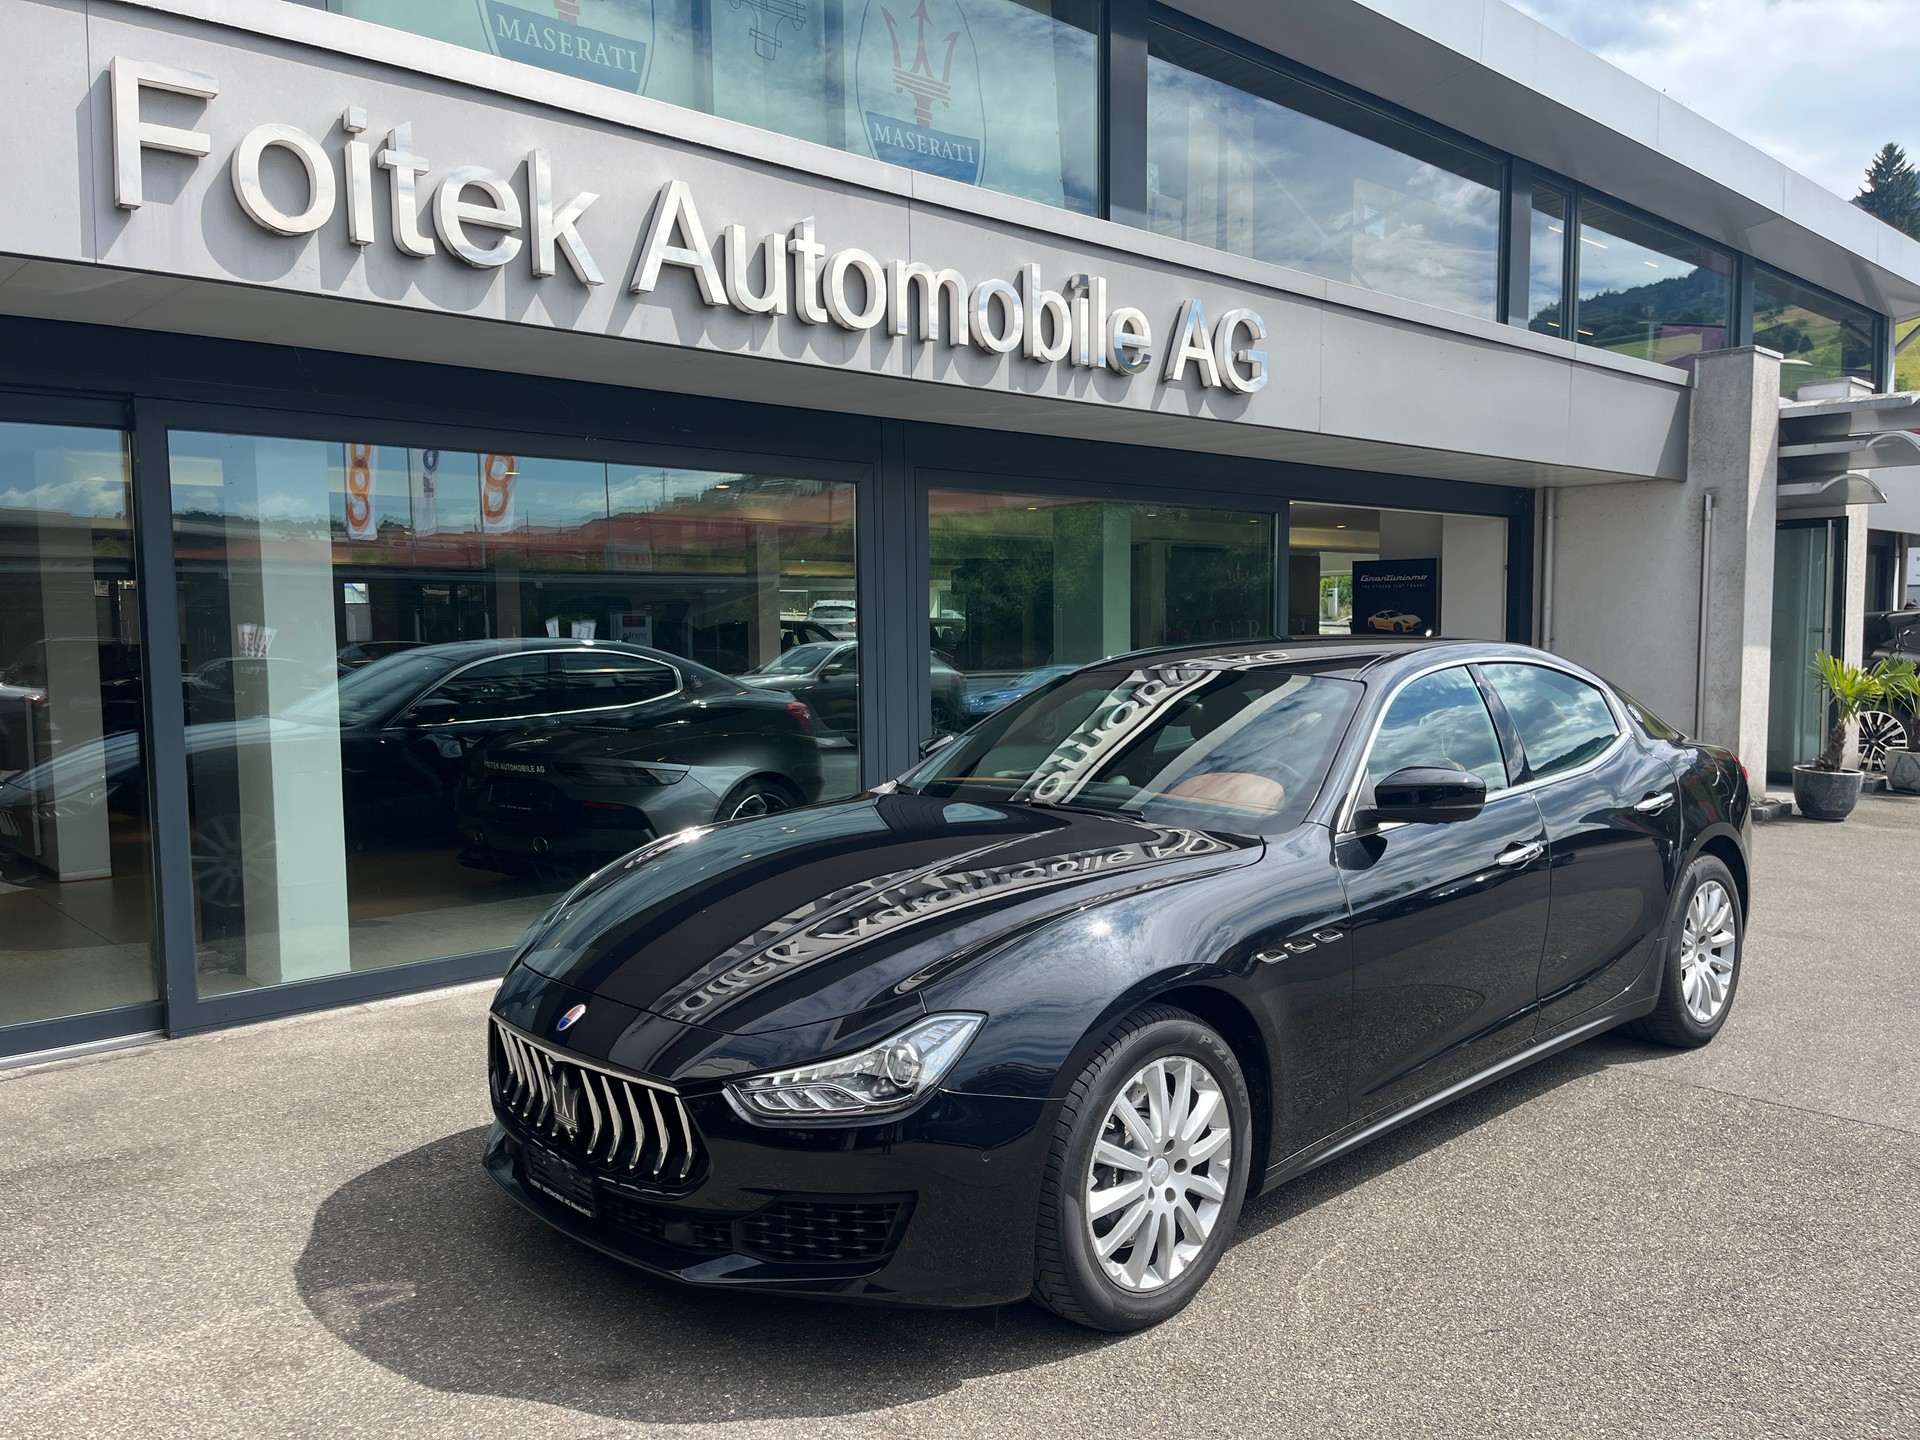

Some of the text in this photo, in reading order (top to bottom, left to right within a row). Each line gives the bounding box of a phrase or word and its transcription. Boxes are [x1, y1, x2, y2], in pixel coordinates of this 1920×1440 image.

[496, 13, 638, 74] MASERATI
[873, 122, 976, 165] MASERATI
[109, 55, 1269, 394] Foitek Automobile AG
[536, 765, 545, 773] AG
[1197, 1034, 1249, 1108] P ZERO
